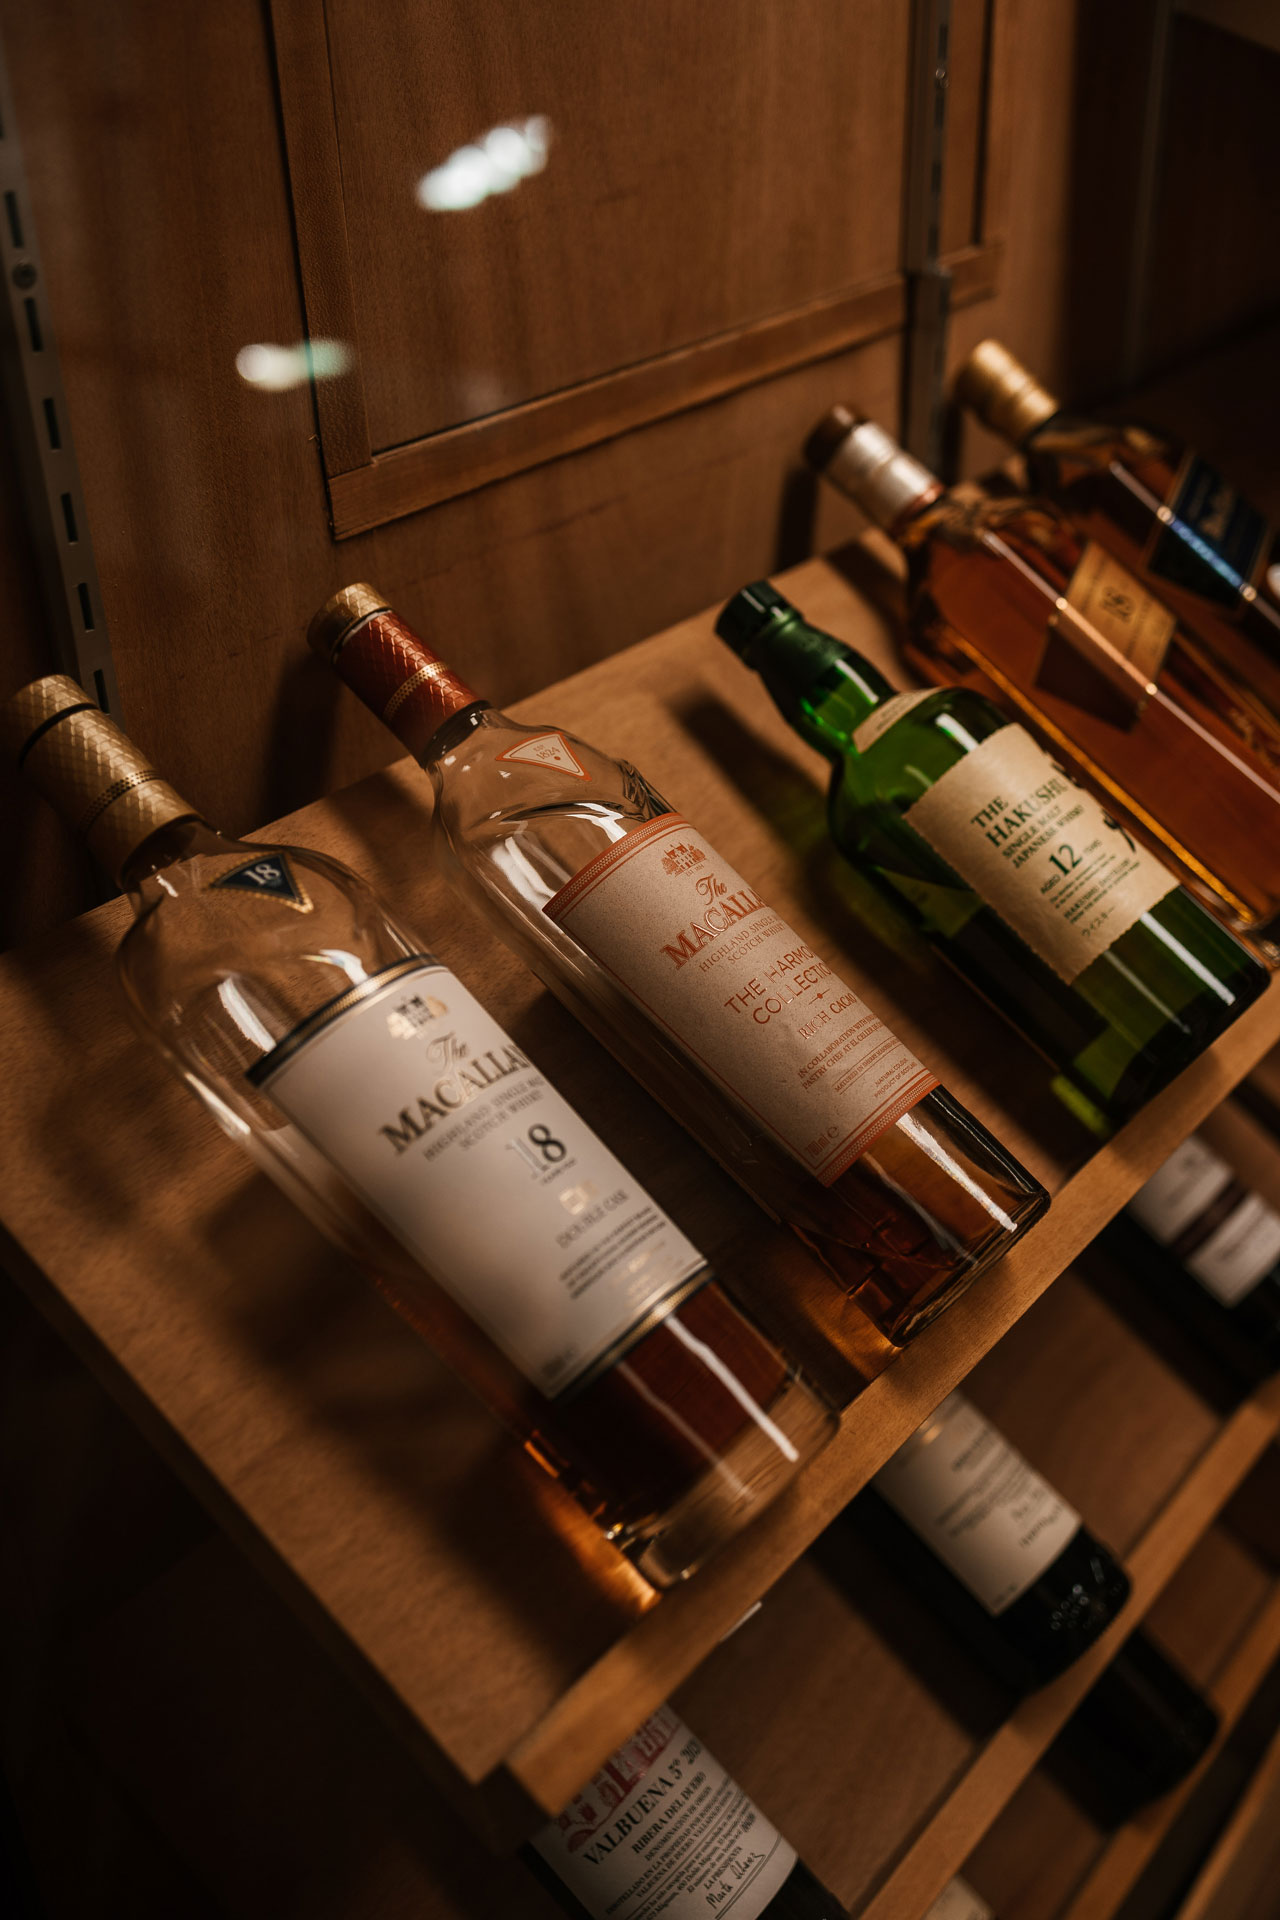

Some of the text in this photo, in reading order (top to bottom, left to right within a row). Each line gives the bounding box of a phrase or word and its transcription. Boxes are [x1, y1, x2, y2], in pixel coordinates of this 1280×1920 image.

[536, 746, 561, 760] 1824
[969, 792, 1010, 832] THE
[984, 773, 1069, 849] HAKUSHU
[1001, 824, 1039, 860] SINGLE
[1049, 843, 1083, 876] 12
[243, 863, 281, 885] 18
[695, 873, 727, 905] The
[698, 914, 775, 973] HIGHLAND SINGLE
[726, 933, 764, 965] SCOTCH
[722, 942, 816, 1017] THE HARMO
[797, 1009, 831, 1040] RICH
[827, 991, 857, 1016] CACAO
[424, 1031, 470, 1072] The
[796, 1067, 809, 1079] IN
[805, 1025, 857, 1070] COLLABORATION
[800, 1063, 829, 1090] PASTRY
[825, 1049, 844, 1068] CHEF
[842, 1042, 853, 1053] AT
[833, 1069, 859, 1092] MATURED
[873, 1077, 897, 1099] PRODUCT
[505, 1122, 567, 1182] 18
[582, 1772, 676, 1869] VALBUENA
[629, 1769, 709, 1855] RIBERA DEL DUERO
[657, 1825, 693, 1862] PROPIEDAD
